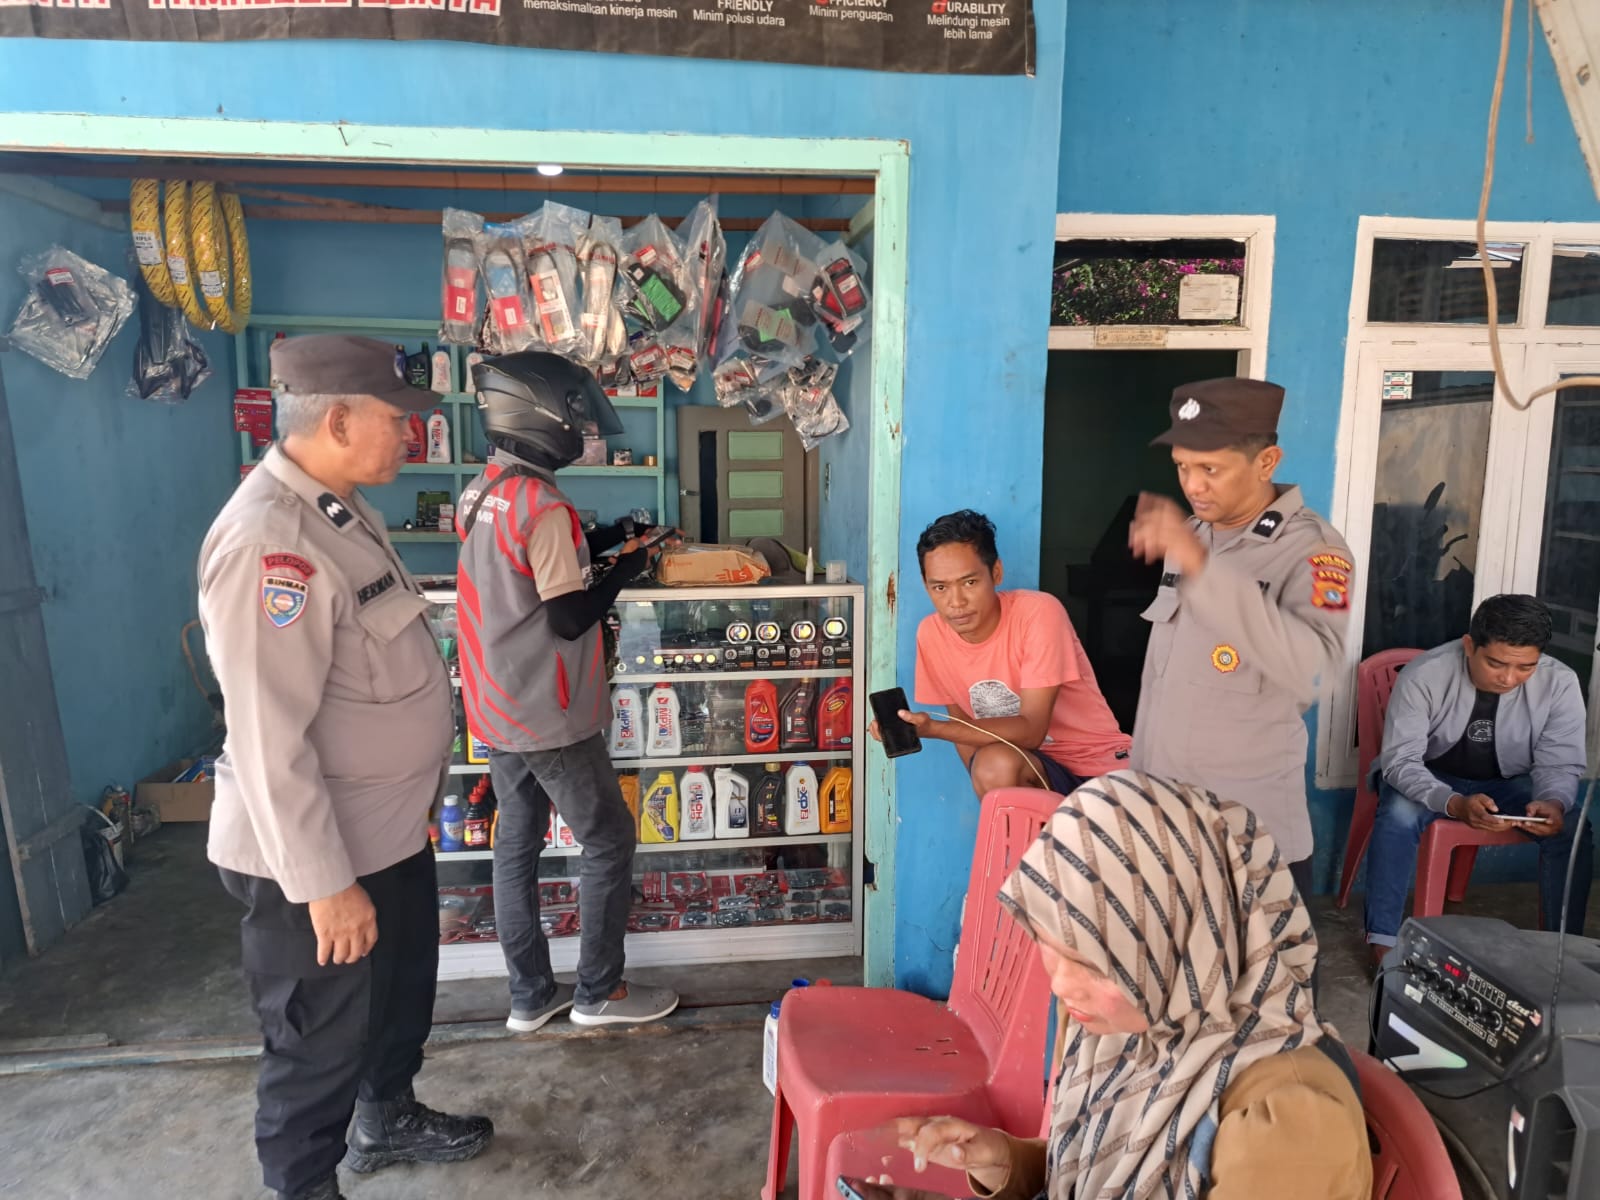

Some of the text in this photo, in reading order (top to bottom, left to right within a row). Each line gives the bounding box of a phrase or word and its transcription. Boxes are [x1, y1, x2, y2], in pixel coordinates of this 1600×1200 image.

[524, 0, 677, 19] memaksimalkan kinerja mesin
[717, 0, 774, 12] FRIENDLY
[809, 5, 893, 23] Minim penguapan
[693, 9, 785, 26] Minim polusi udara
[927, 14, 1010, 29] Melindungi mesin
[944, 28, 993, 40] lebih lama
